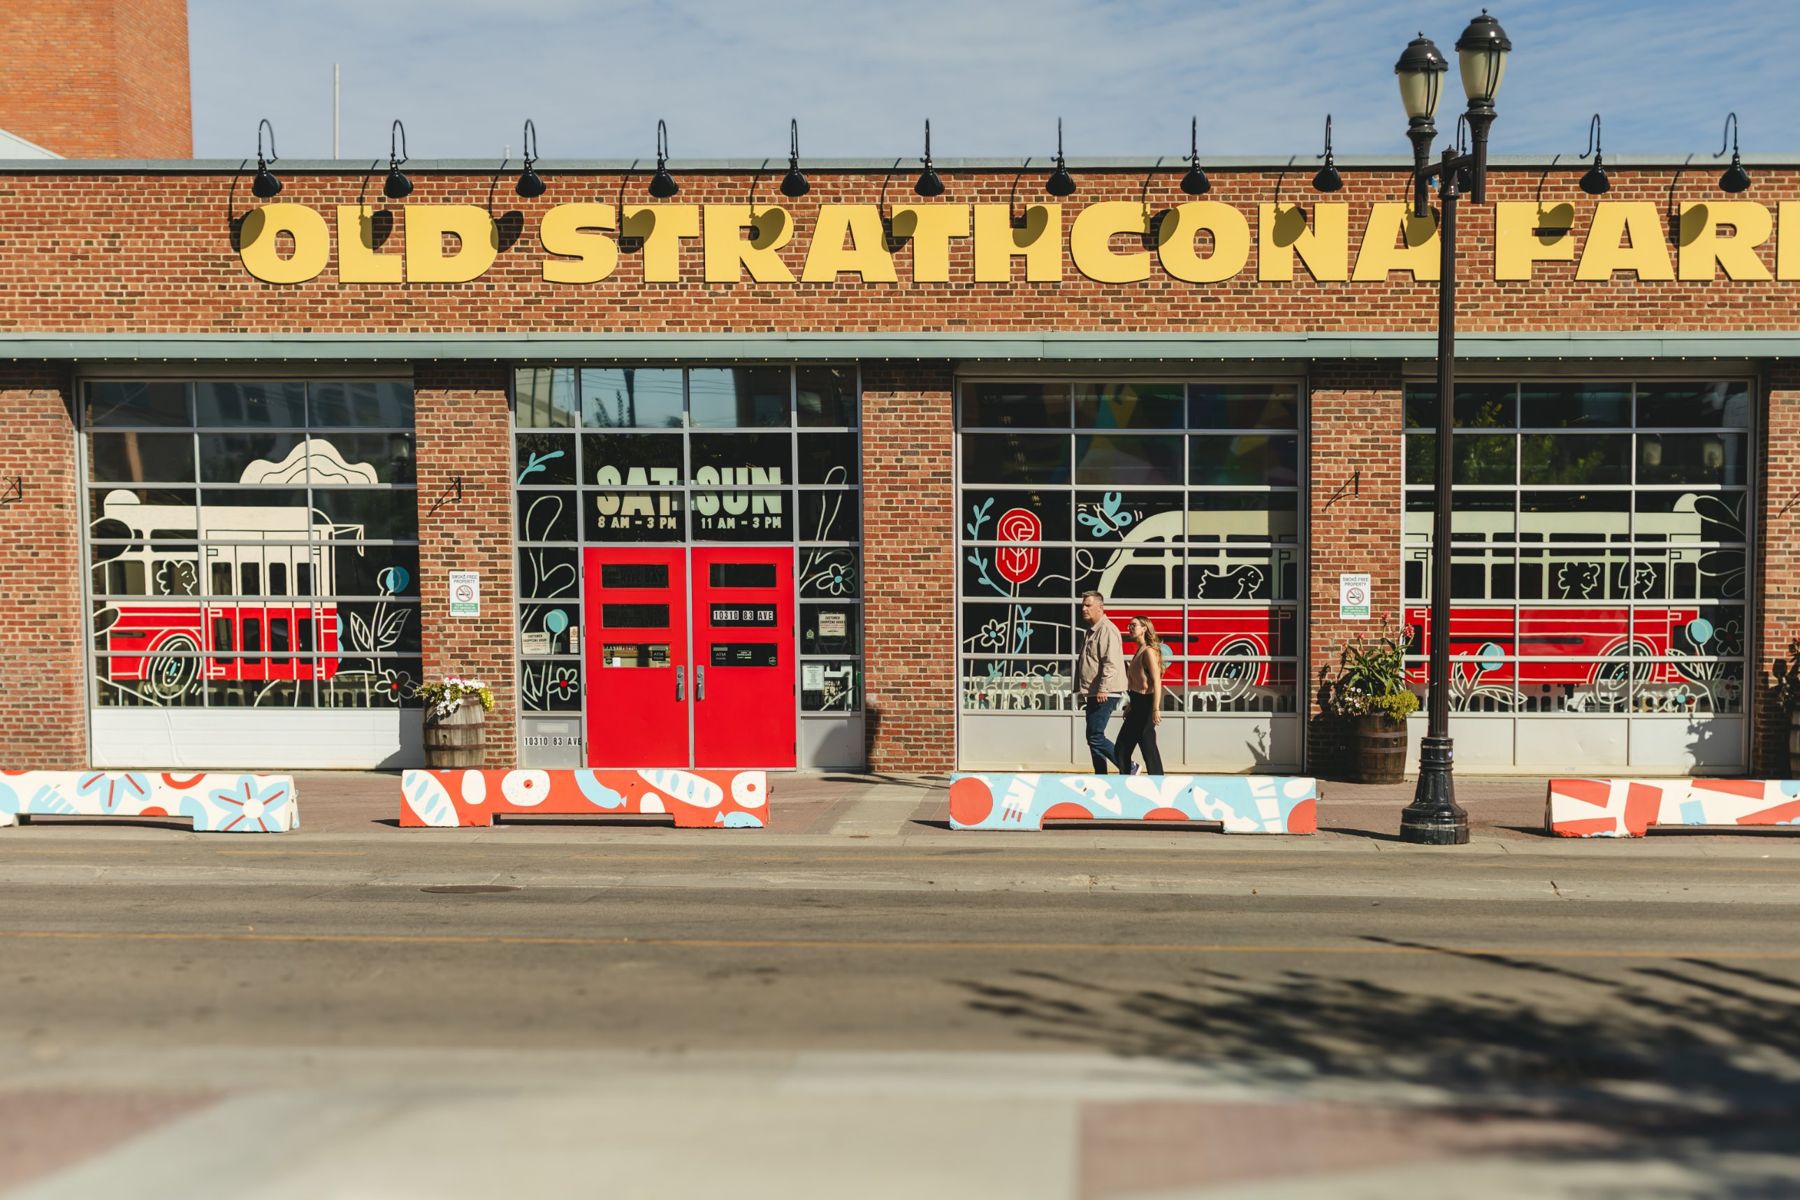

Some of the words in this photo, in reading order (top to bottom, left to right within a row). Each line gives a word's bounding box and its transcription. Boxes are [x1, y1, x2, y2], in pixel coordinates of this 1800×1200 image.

[240, 202, 498, 284] OLD
[540, 201, 1441, 284] STRATHCONA
[1495, 201, 1800, 281] FAR
[597, 465, 678, 515] SAT
[697, 465, 783, 516] SUN
[598, 516, 606, 529] 8
[611, 517, 630, 529] AM
[647, 517, 655, 529] 3
[660, 517, 677, 529] PM
[701, 517, 712, 529] 11
[718, 517, 736, 529] AM
[752, 517, 760, 529] 3
[765, 517, 782, 529] PM
[713, 610, 739, 620] 10310
[743, 610, 754, 620] 83
[757, 610, 773, 620] AVE
[525, 737, 548, 746] 10310
[553, 737, 563, 746] 83
[567, 737, 582, 746] AVE
